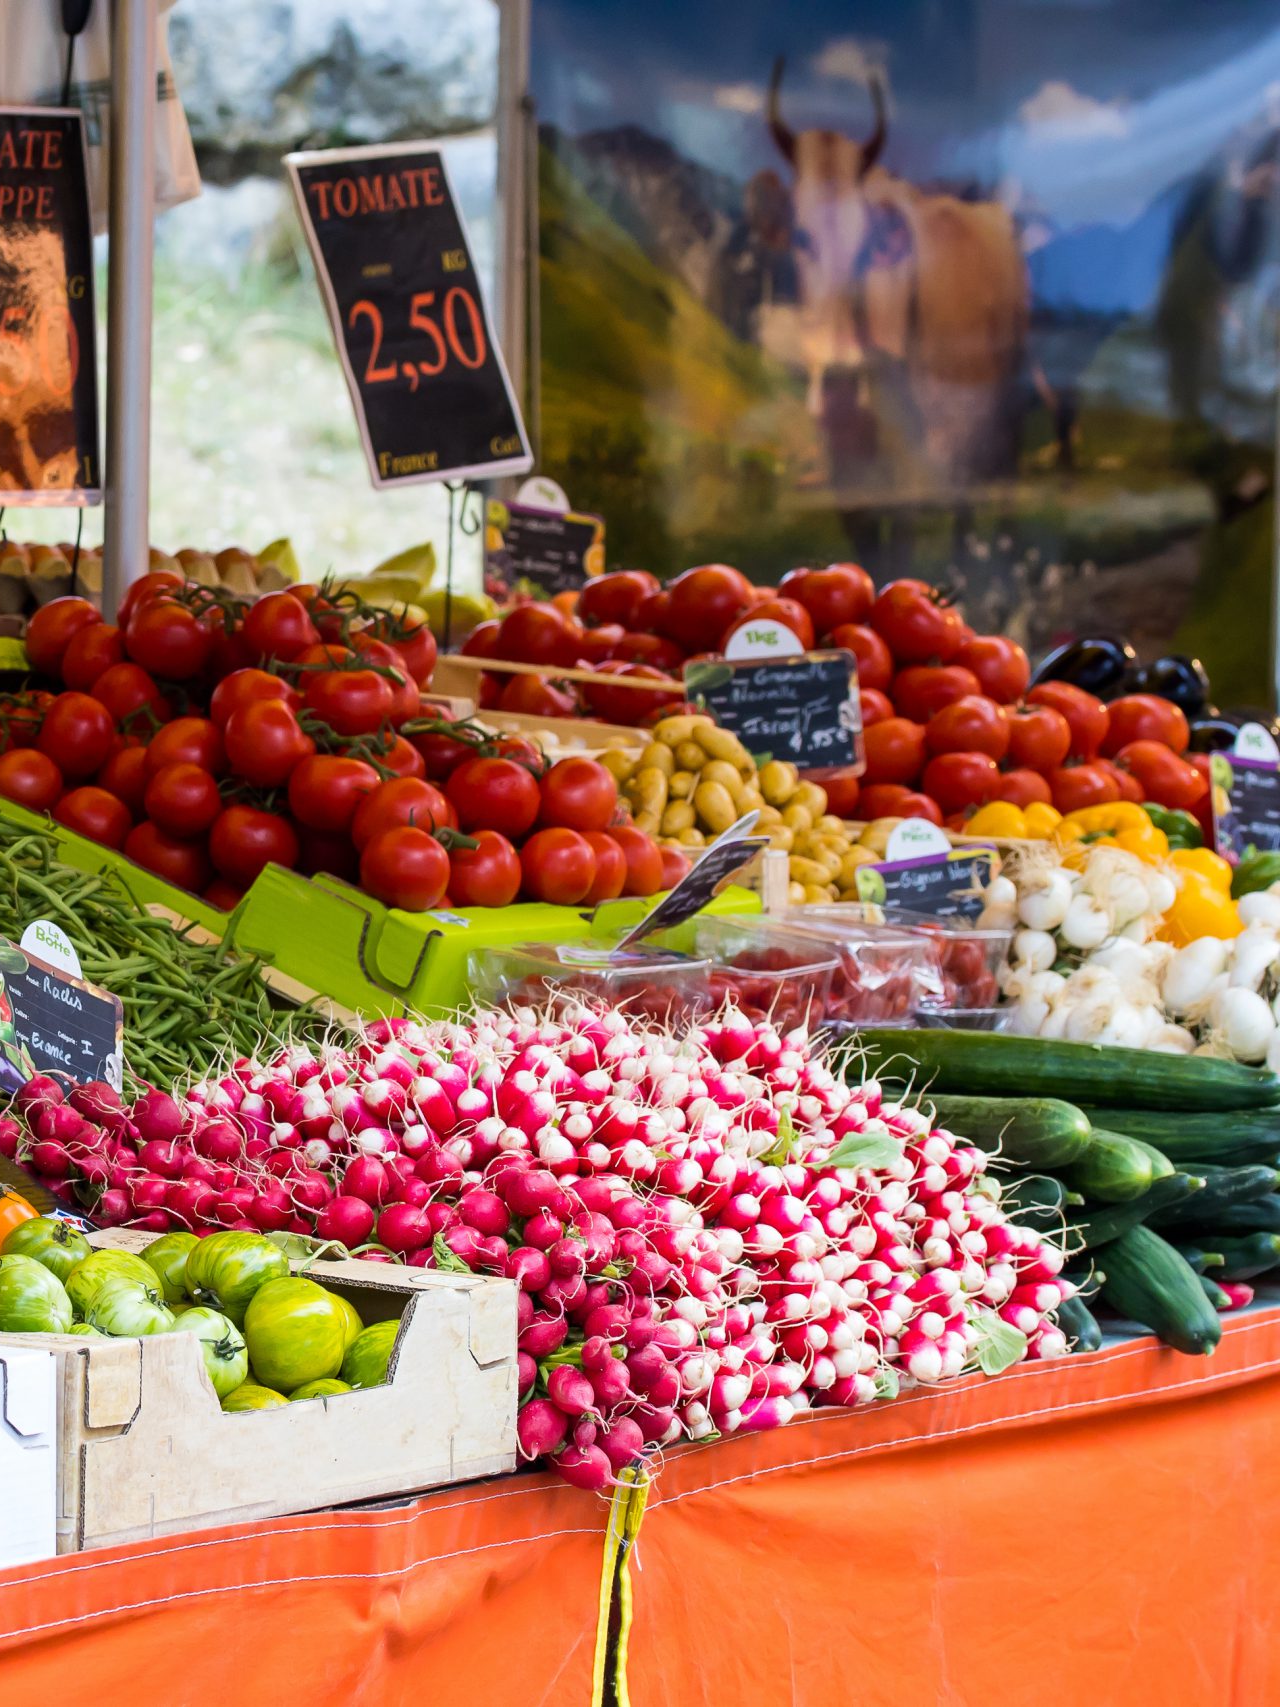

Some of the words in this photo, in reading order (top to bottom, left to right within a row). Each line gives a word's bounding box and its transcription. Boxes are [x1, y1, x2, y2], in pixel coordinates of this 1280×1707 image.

[310, 167, 445, 221] TOMATE
[349, 287, 486, 393] 2,50
[35, 925, 71, 958] Botte
[48, 926, 59, 940] La
[42, 975, 83, 1011] Radis
